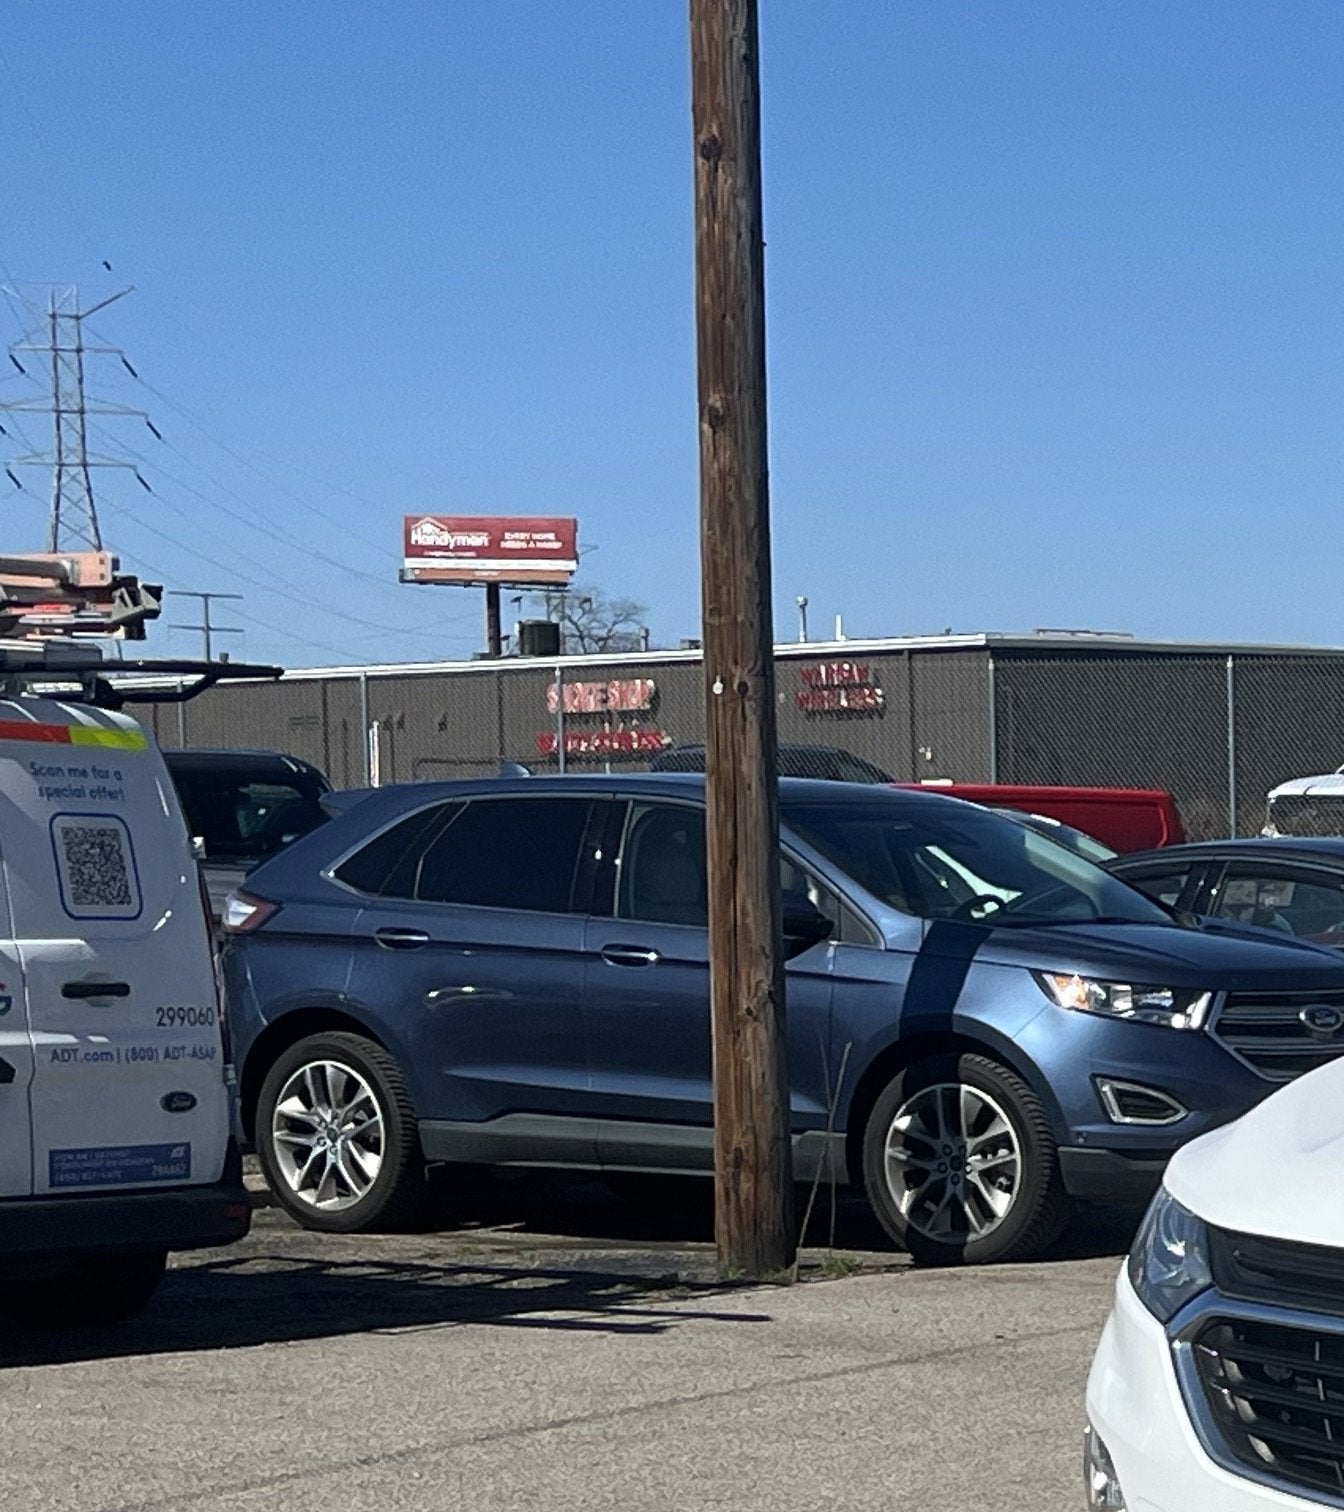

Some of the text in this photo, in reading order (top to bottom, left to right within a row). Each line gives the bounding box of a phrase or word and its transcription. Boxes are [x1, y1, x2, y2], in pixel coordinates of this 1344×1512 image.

[411, 524, 490, 549] Handyman
[30, 761, 122, 781] Scan me for a
[38, 785, 86, 801] special
[156, 1006, 215, 1028] 299060
[51, 1048, 114, 1063] ADT.com
[125, 1046, 160, 1064] (800)
